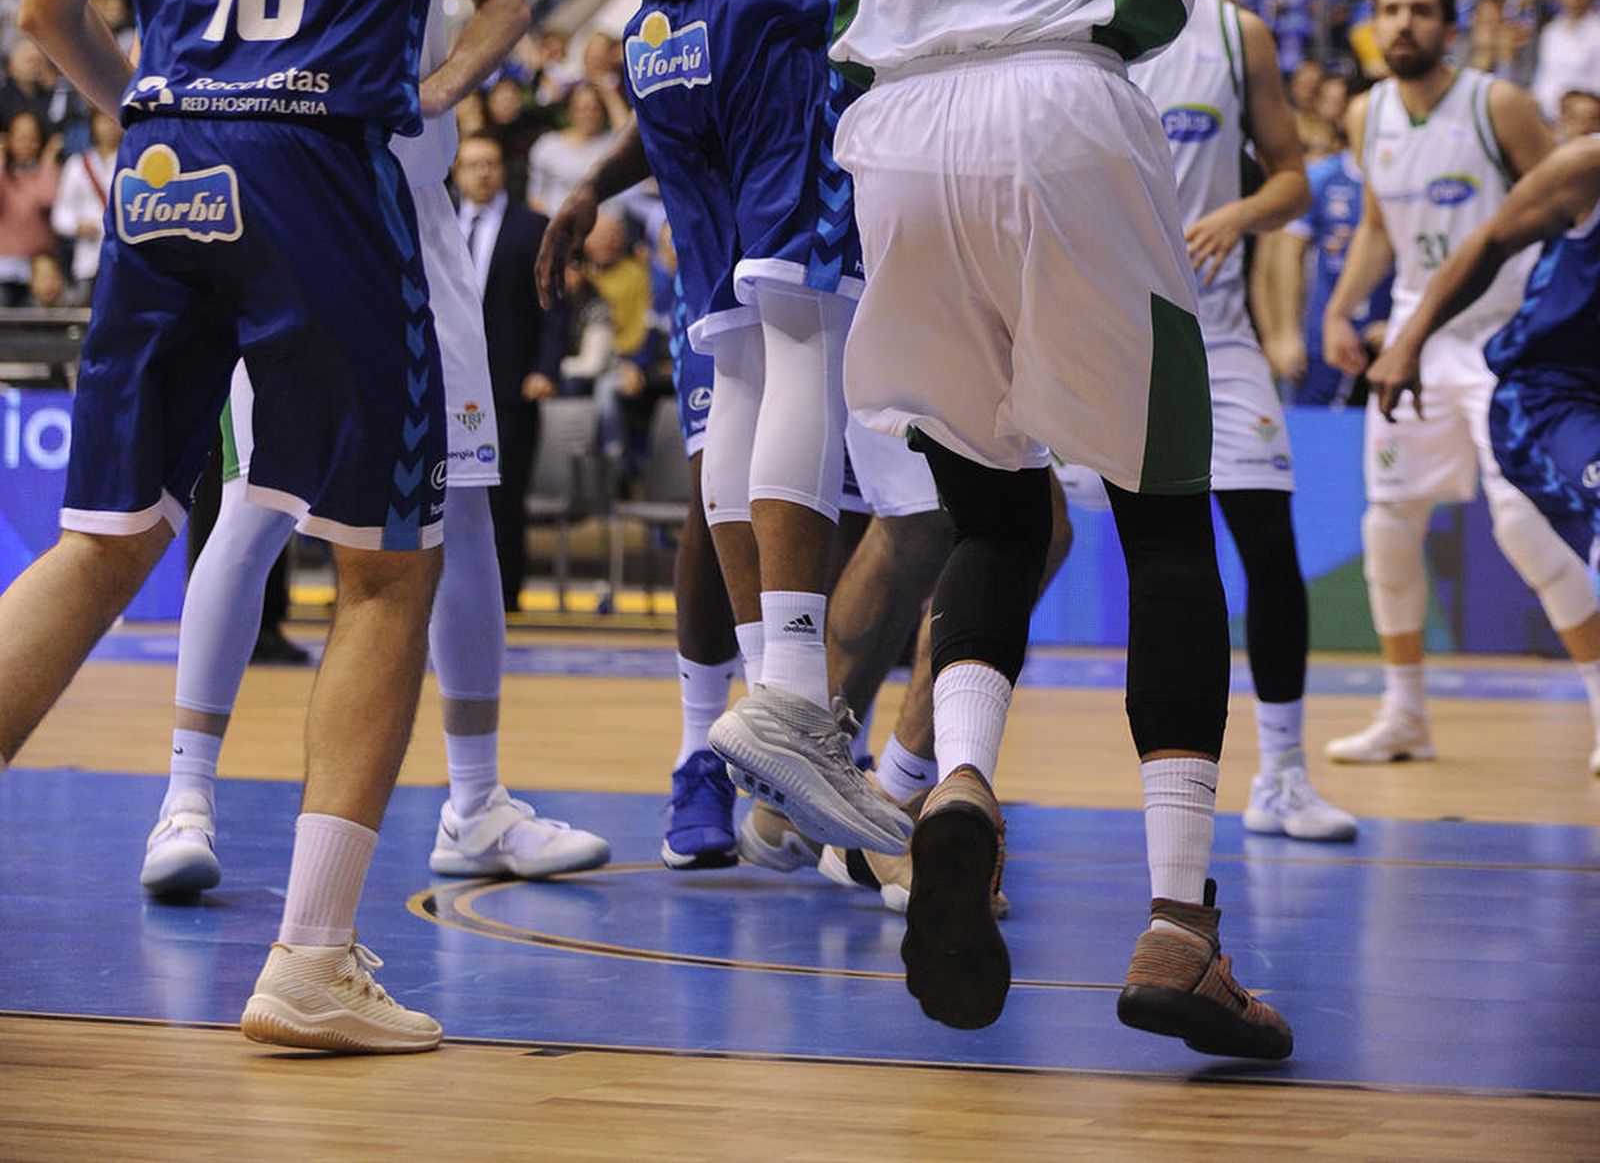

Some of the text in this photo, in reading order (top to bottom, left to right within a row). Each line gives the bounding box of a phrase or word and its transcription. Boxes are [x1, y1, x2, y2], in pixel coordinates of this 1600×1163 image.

[181, 96, 328, 115] RED HOSPITALARIA
[125, 191, 228, 222] florbú
